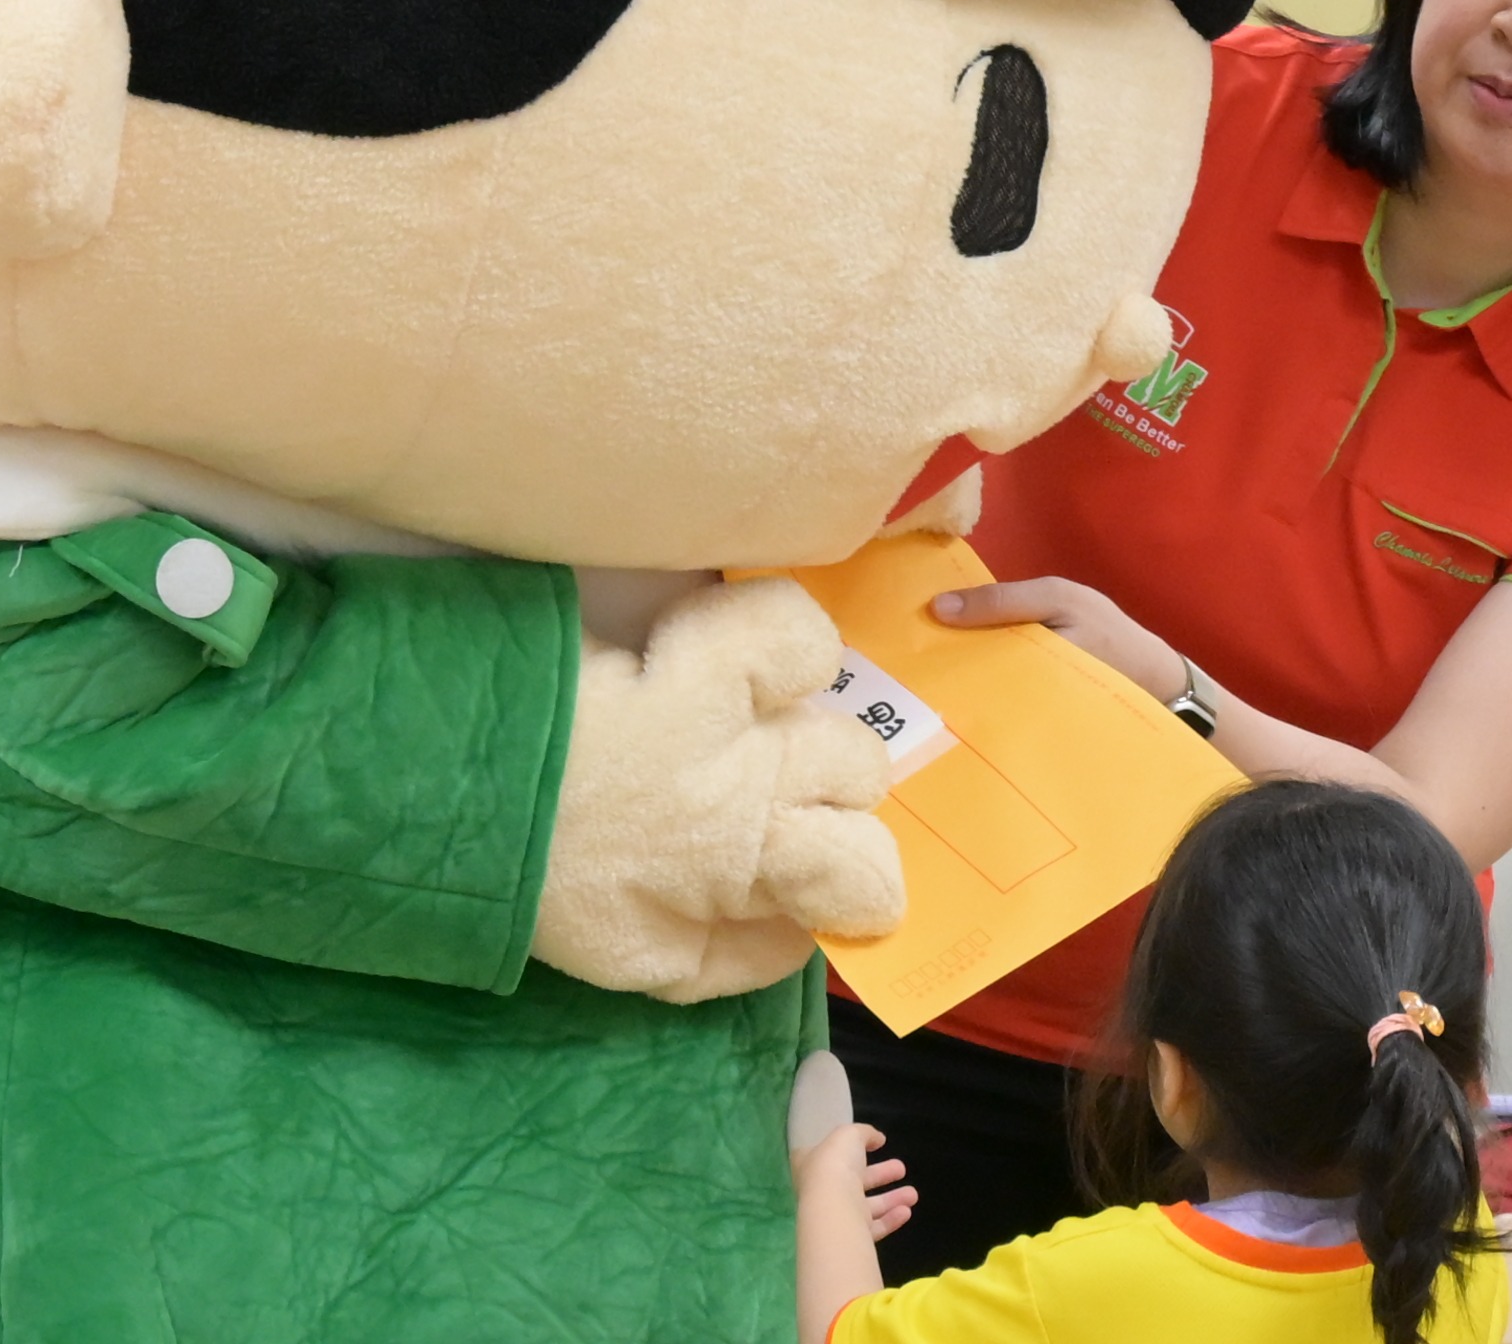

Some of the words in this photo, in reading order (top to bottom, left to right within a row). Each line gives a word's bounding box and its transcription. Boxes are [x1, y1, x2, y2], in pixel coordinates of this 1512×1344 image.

[1103, 418, 1161, 458] SUPEREGO
[1114, 403, 1136, 424] Be
[1136, 417, 1186, 453] Better
